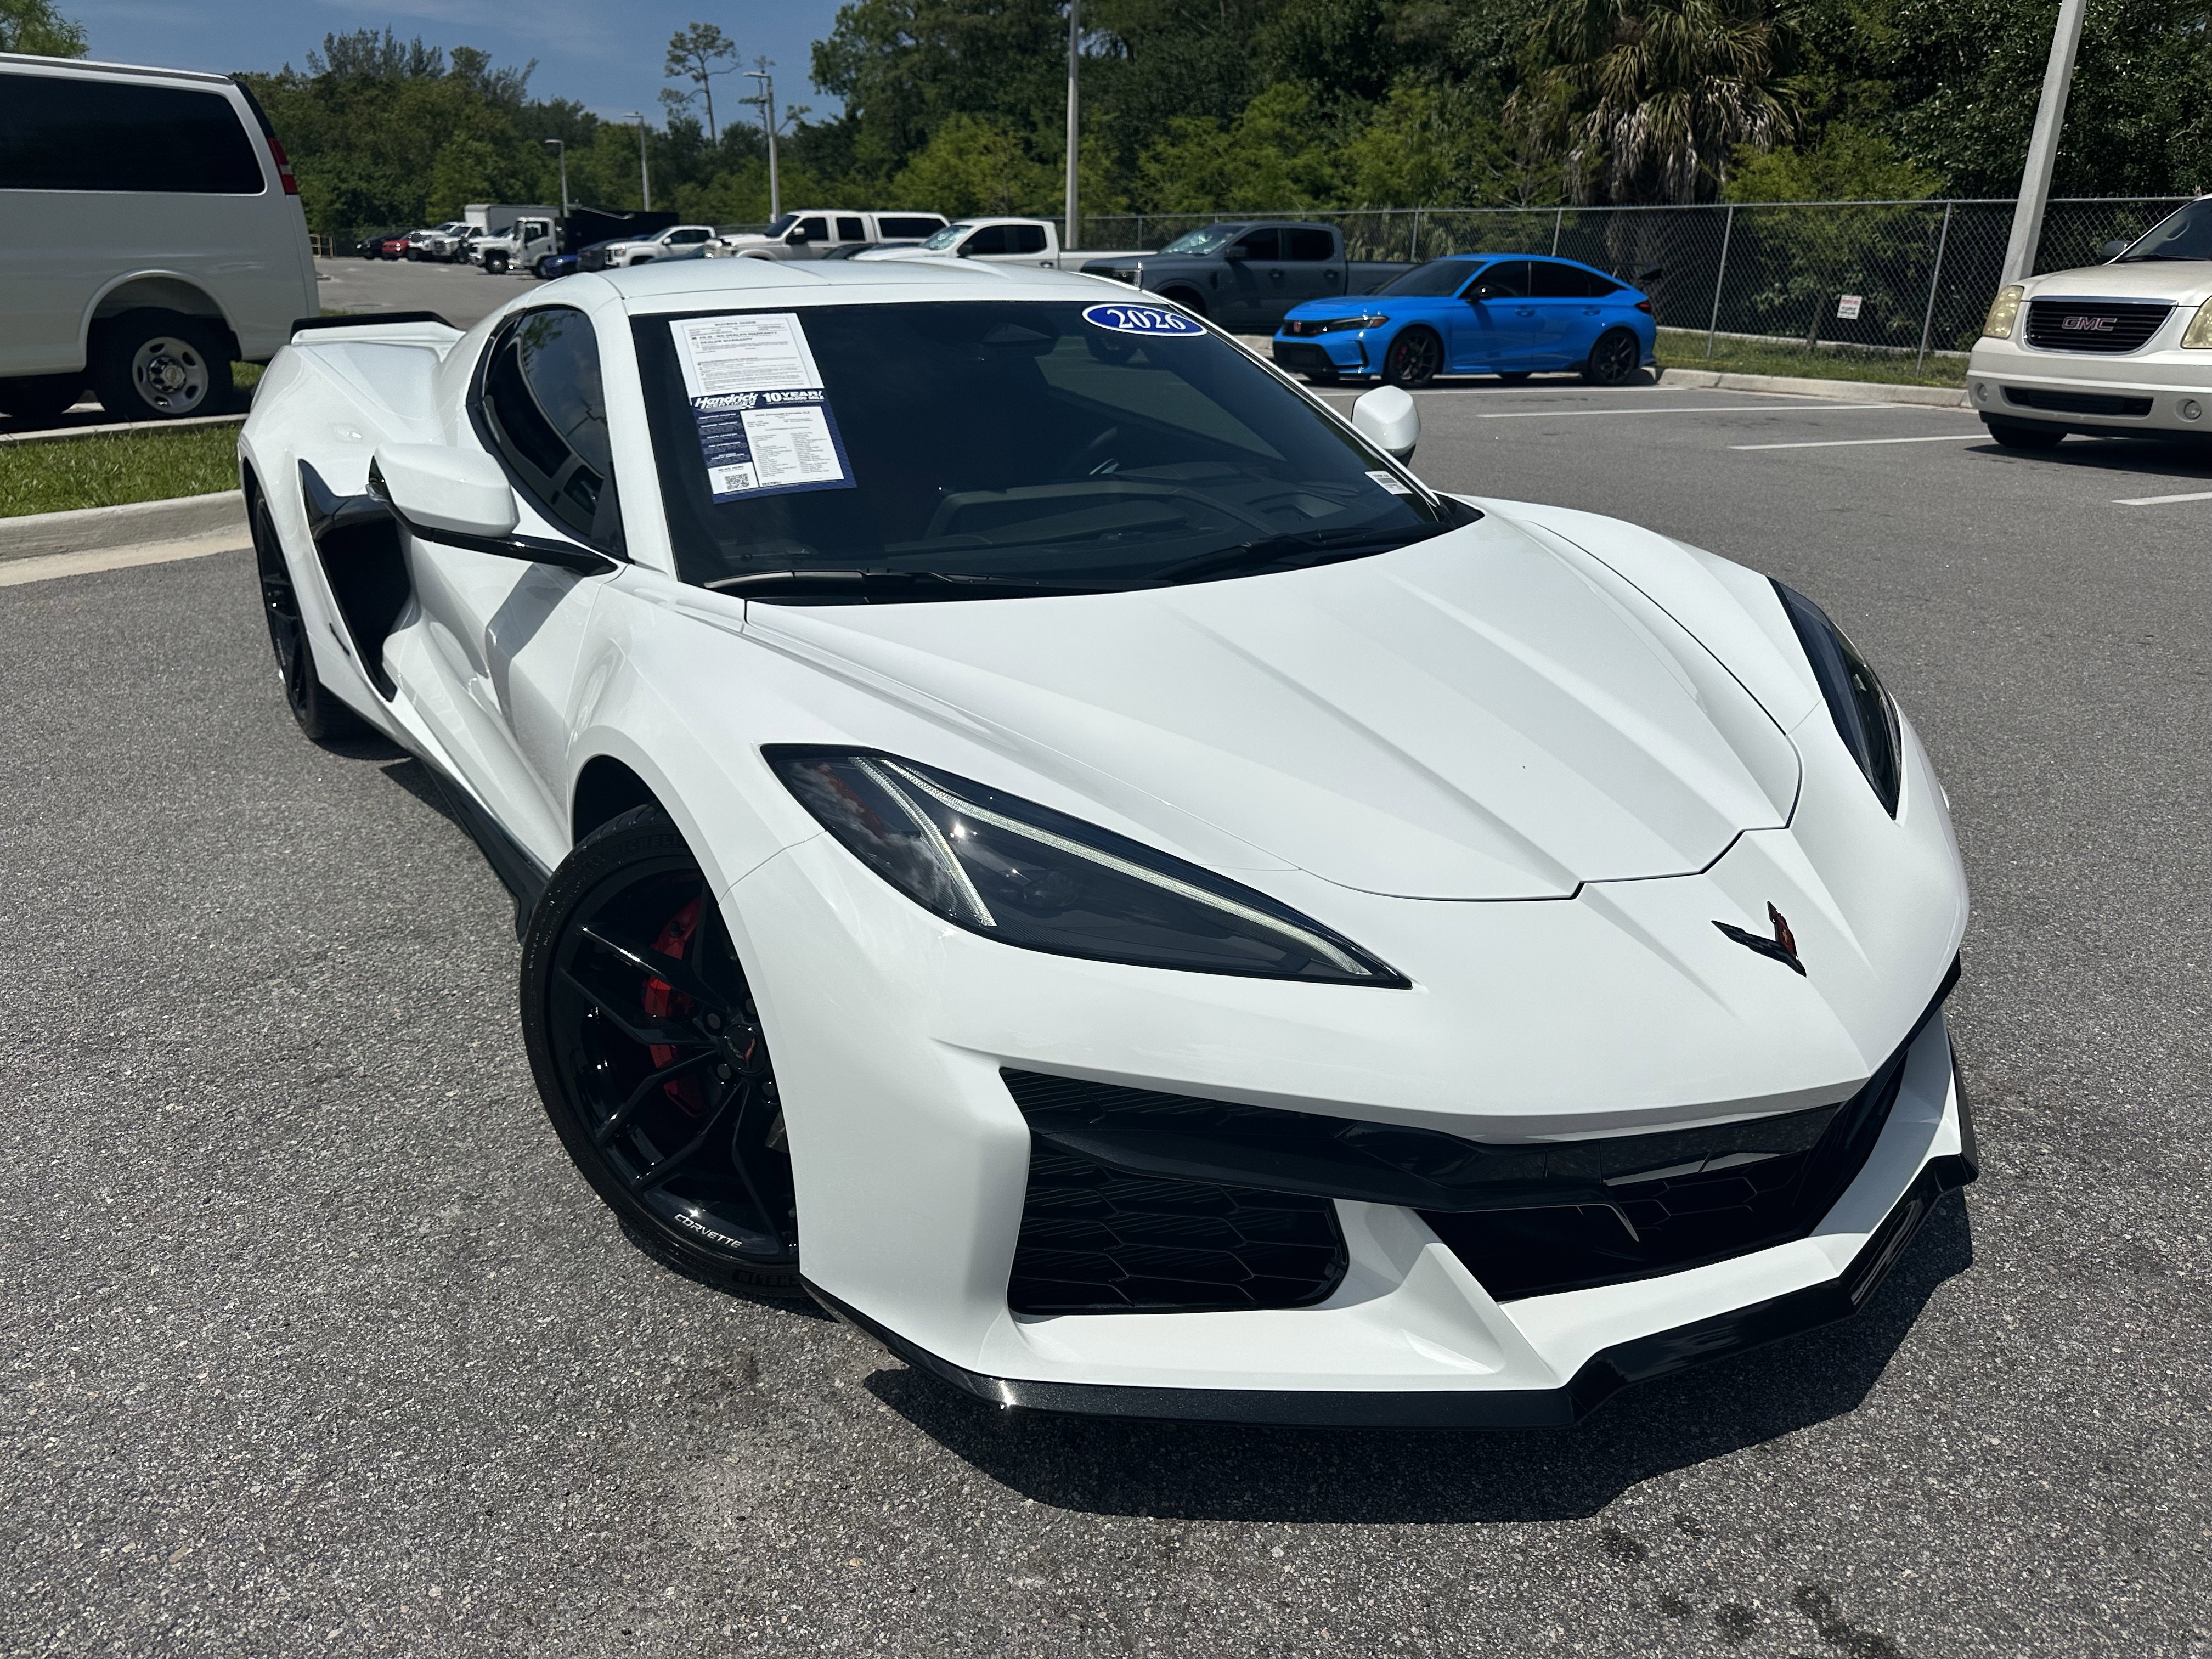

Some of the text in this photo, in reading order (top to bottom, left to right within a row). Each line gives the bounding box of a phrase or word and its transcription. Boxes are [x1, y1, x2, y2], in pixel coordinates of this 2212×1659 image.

[1107, 309, 1186, 330] 2026
[2061, 316, 2118, 331] GMC
[763, 393, 782, 402] 10
[674, 1214, 743, 1248] CORVETTE
